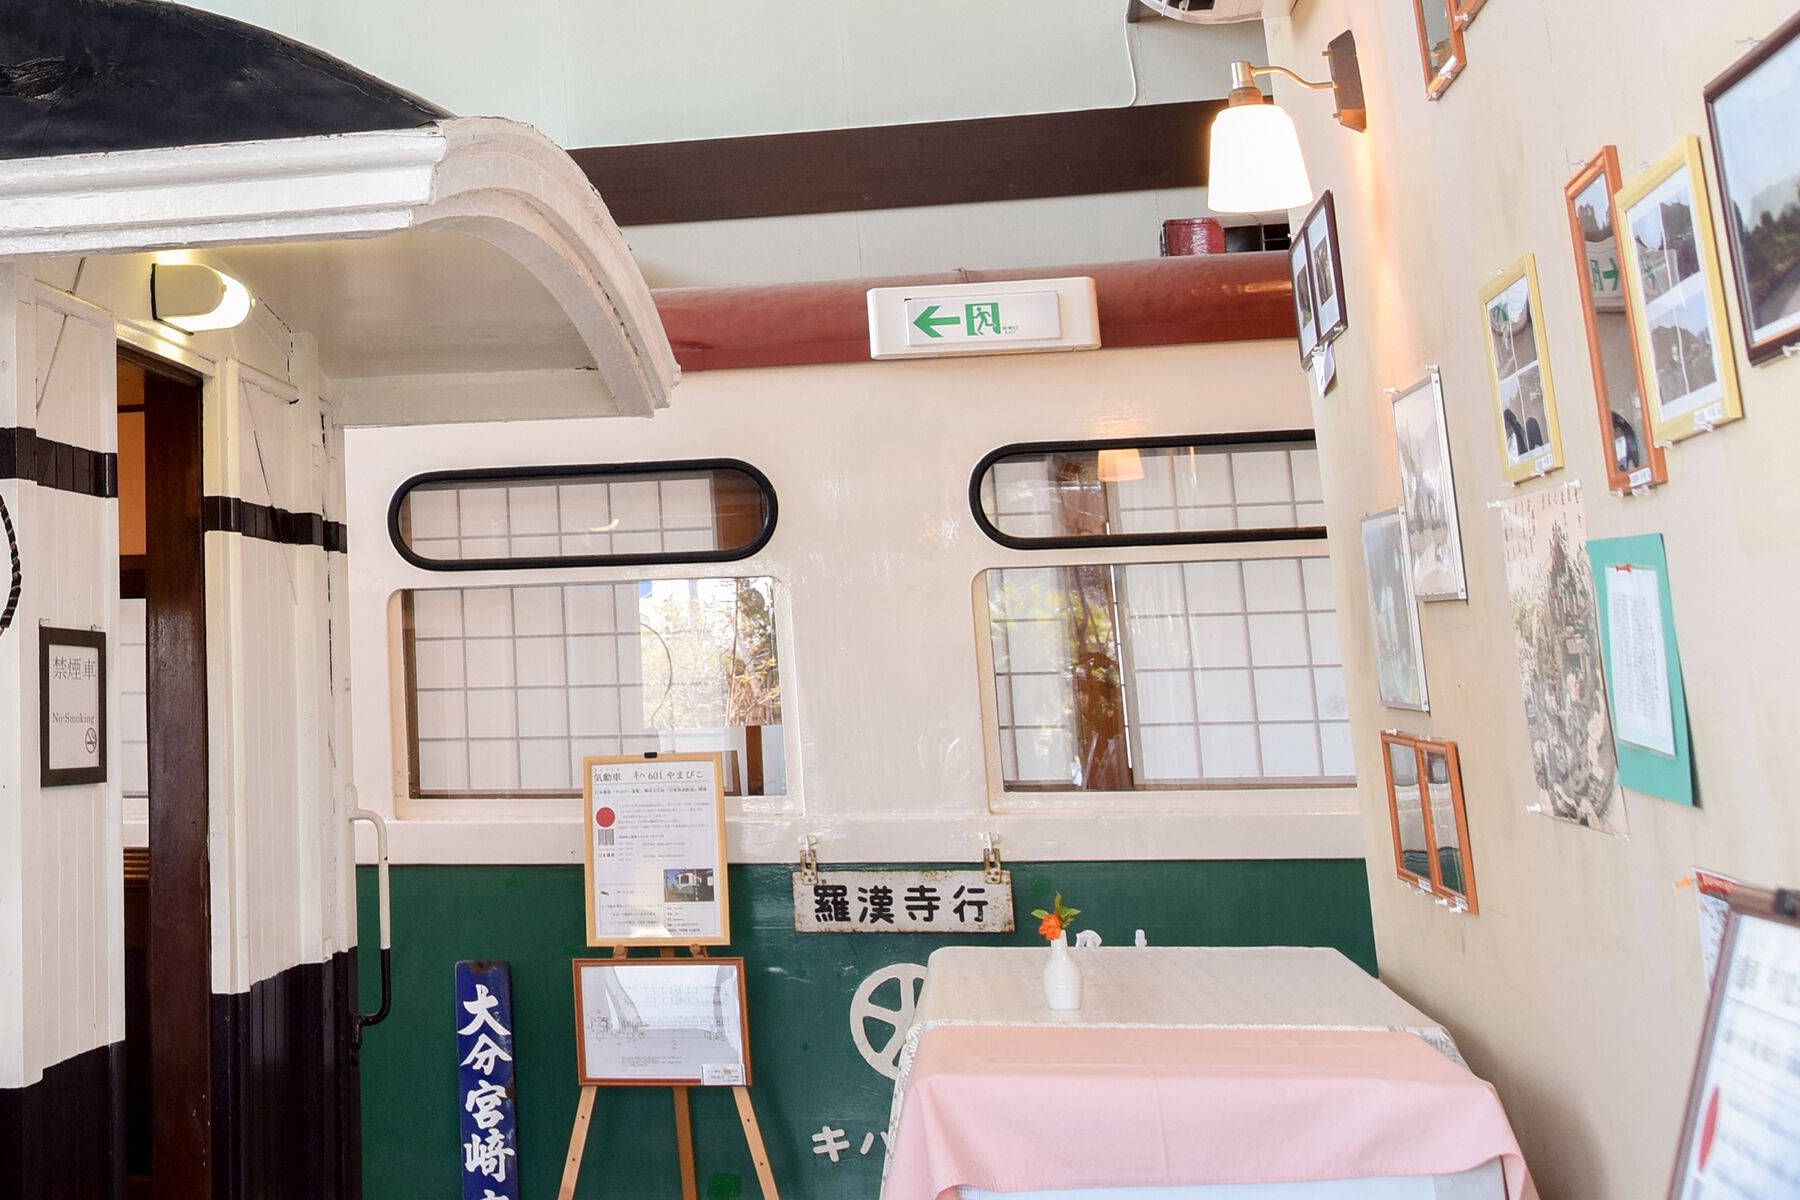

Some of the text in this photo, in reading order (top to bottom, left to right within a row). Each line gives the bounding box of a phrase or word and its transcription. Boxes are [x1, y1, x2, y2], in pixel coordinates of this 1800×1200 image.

[52, 656, 97, 680] 禁煙車
[52, 712, 95, 725] No Smoking
[813, 884, 990, 924] 羅漢寺行
